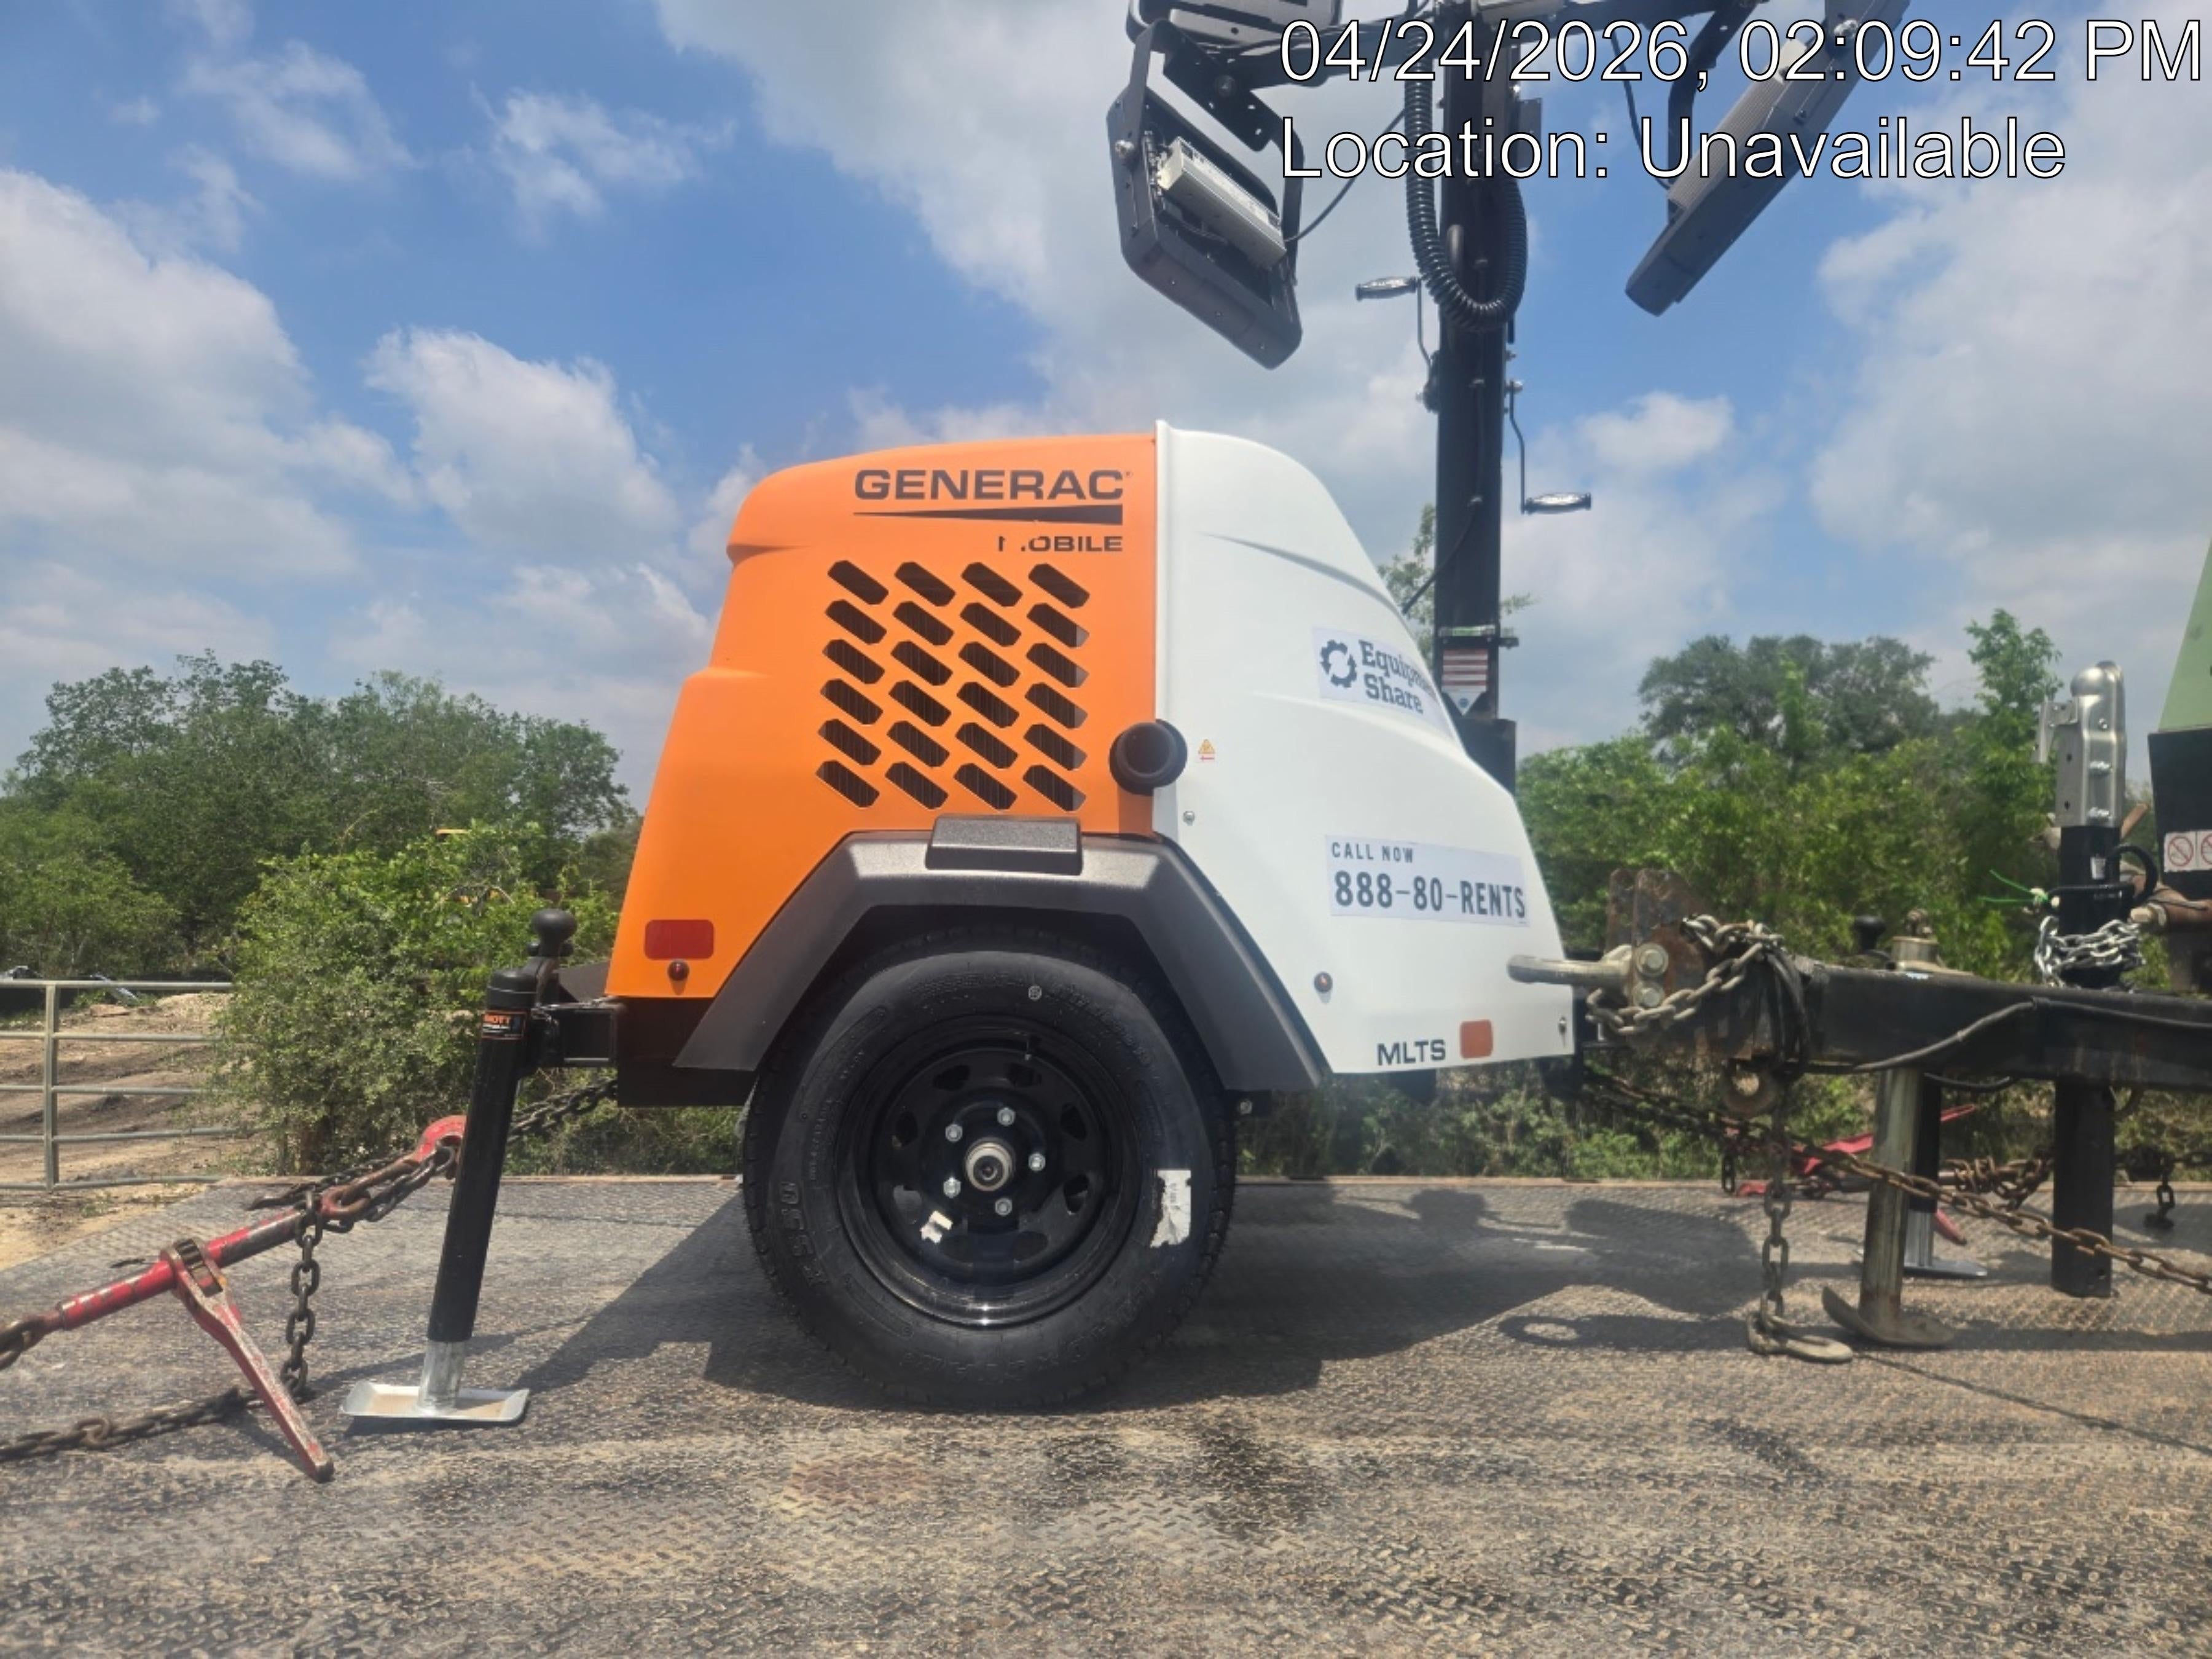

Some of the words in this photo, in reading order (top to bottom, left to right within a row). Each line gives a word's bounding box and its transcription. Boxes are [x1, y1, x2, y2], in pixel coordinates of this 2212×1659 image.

[855, 469, 1123, 500] GENERAC
[1363, 672, 1424, 715] Share
[1331, 841, 1374, 860] CALL
[1382, 845, 1413, 863] NOW
[1334, 869, 1526, 919] 888-80-RENTS
[1376, 1038, 1446, 1066] MLTS
